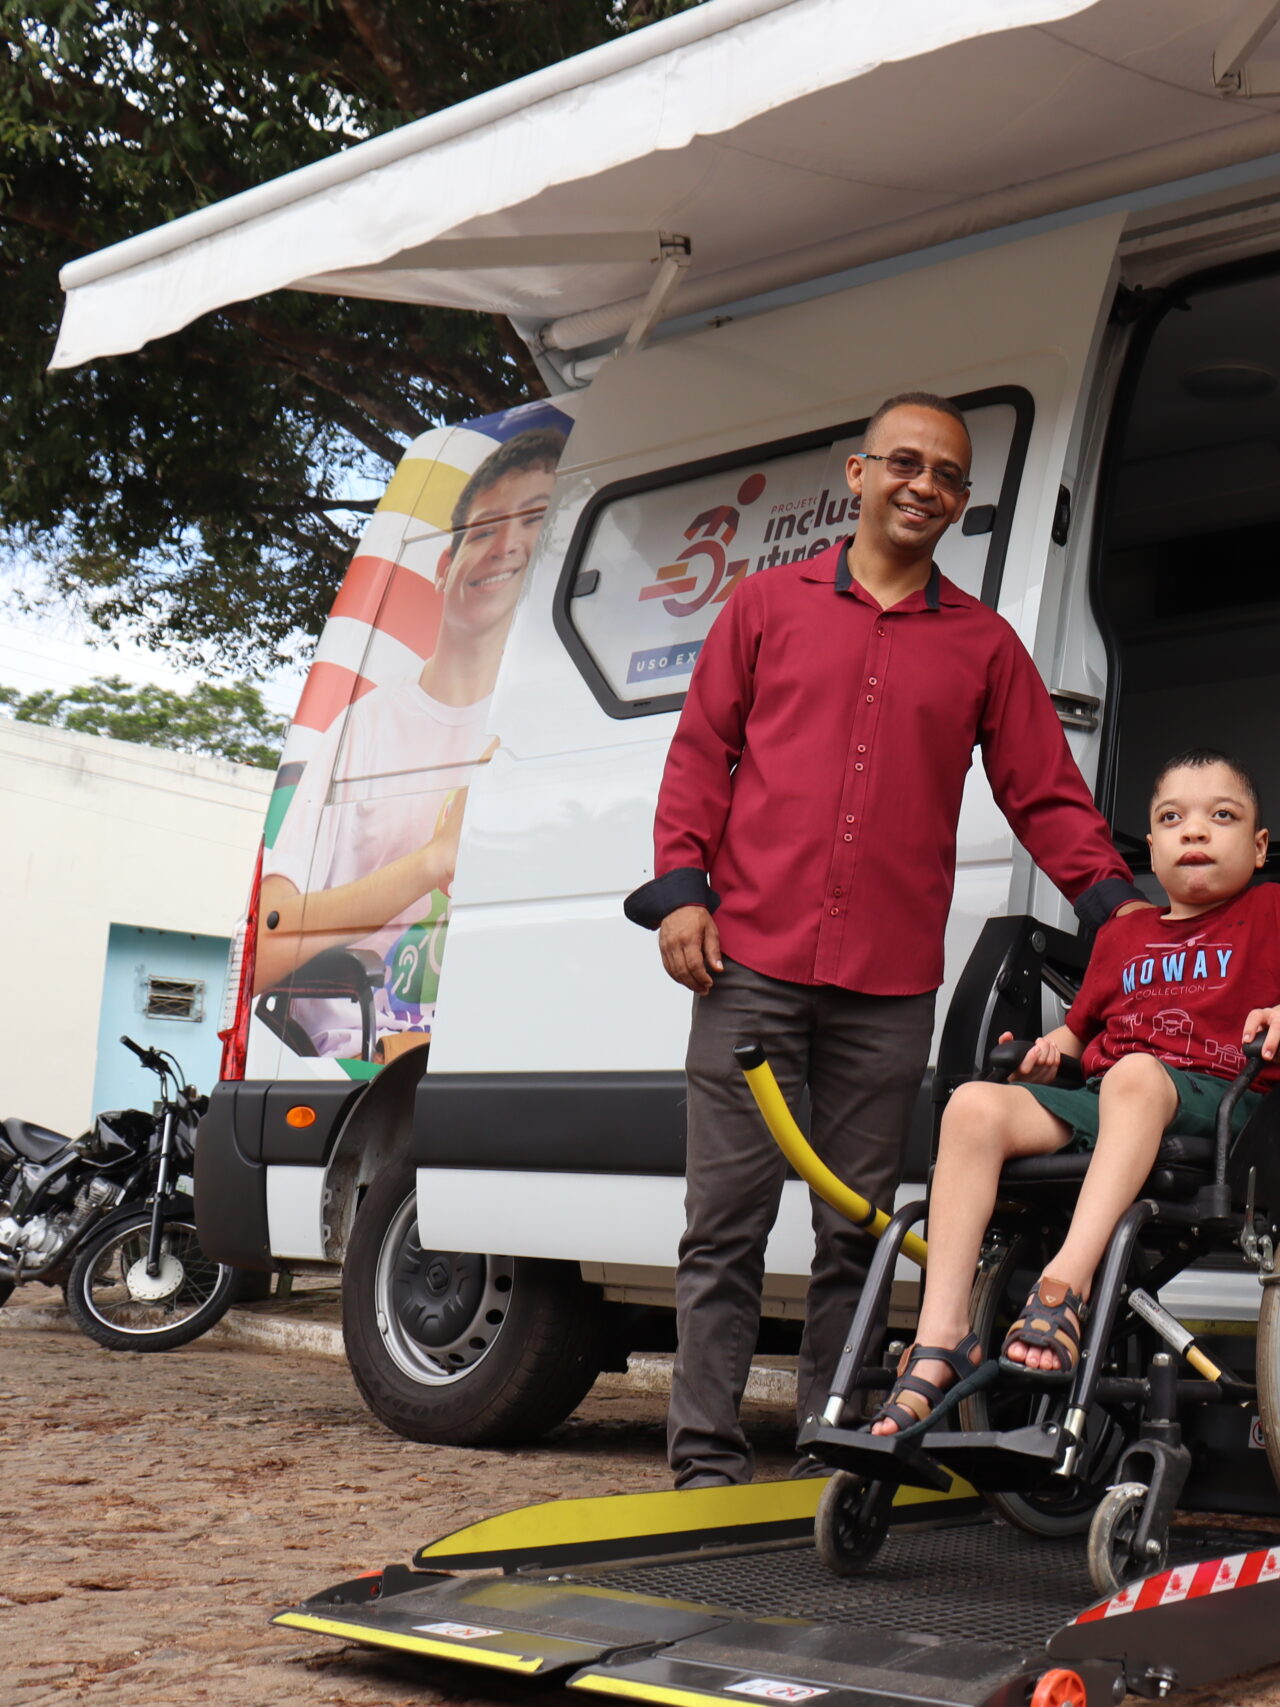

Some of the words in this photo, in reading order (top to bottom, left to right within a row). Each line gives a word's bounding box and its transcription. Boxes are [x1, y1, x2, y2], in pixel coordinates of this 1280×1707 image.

[636, 657, 668, 672] USO
[675, 651, 697, 666] EX
[1122, 949, 1233, 995] MOWAY
[1135, 984, 1206, 1000] COLLECTION
